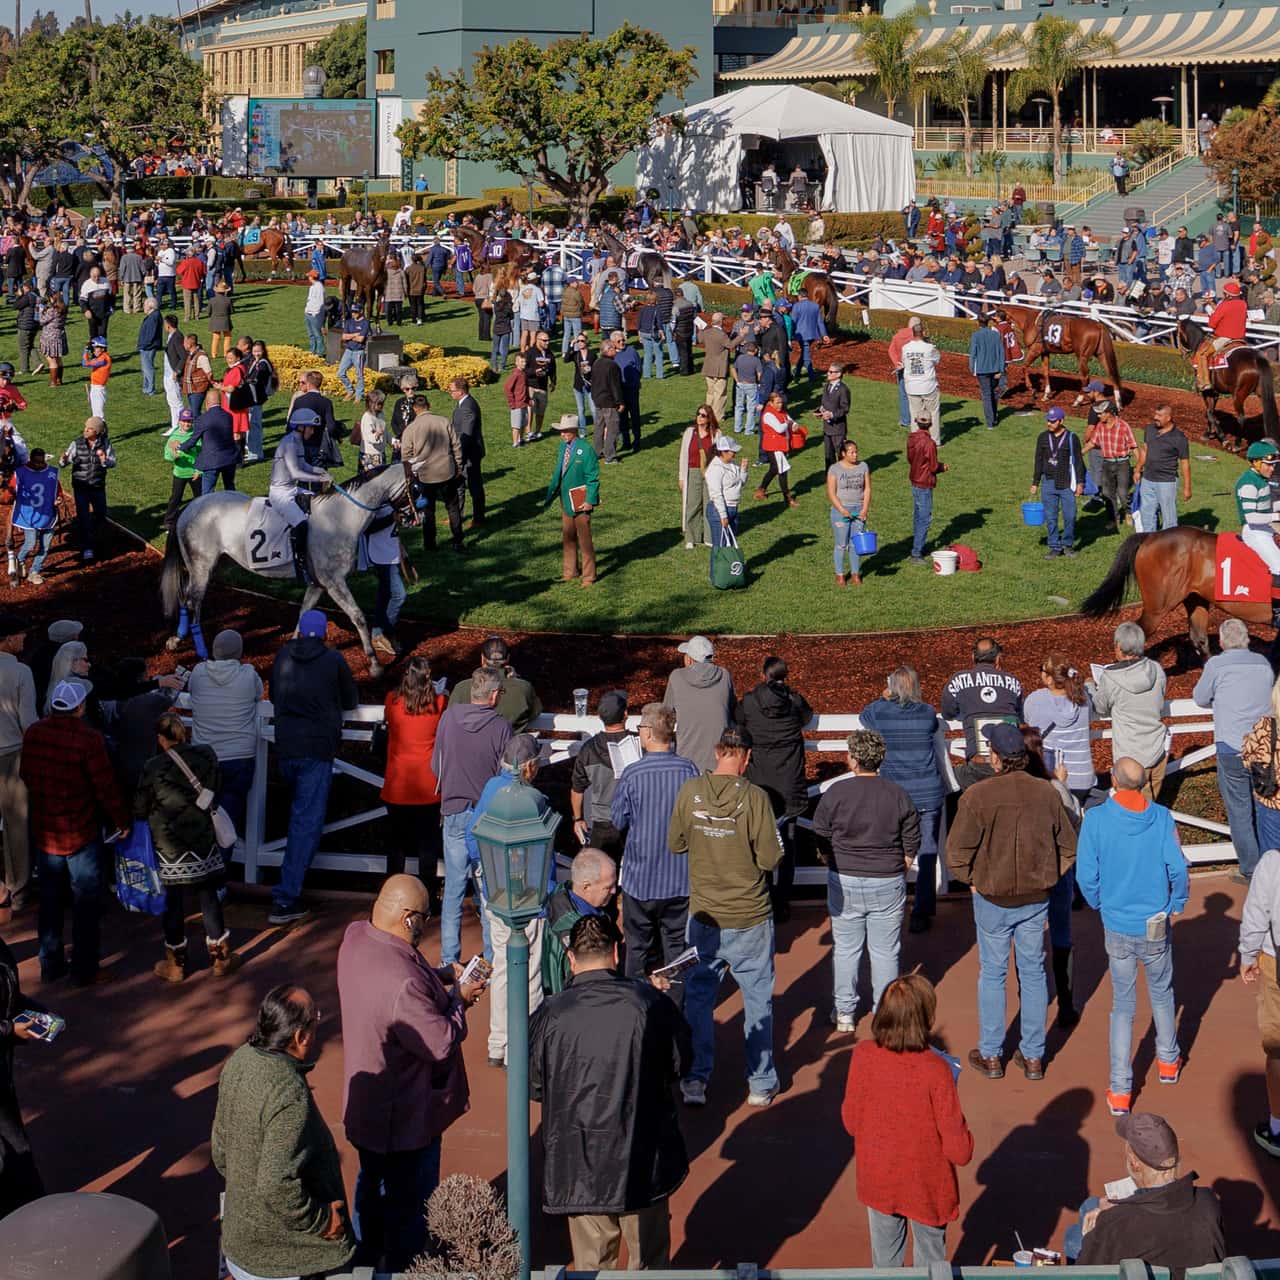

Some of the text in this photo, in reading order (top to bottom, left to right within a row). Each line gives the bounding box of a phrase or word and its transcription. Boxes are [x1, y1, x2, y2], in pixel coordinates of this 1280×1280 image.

[492, 244, 503, 257] 10
[1003, 332, 1015, 348] 13
[1047, 324, 1062, 343] 13
[31, 483, 45, 507] 3
[250, 529, 269, 563] 2
[1220, 557, 1231, 595] 1
[947, 673, 974, 698] SANTA
[975, 672, 1005, 687] ANITA
